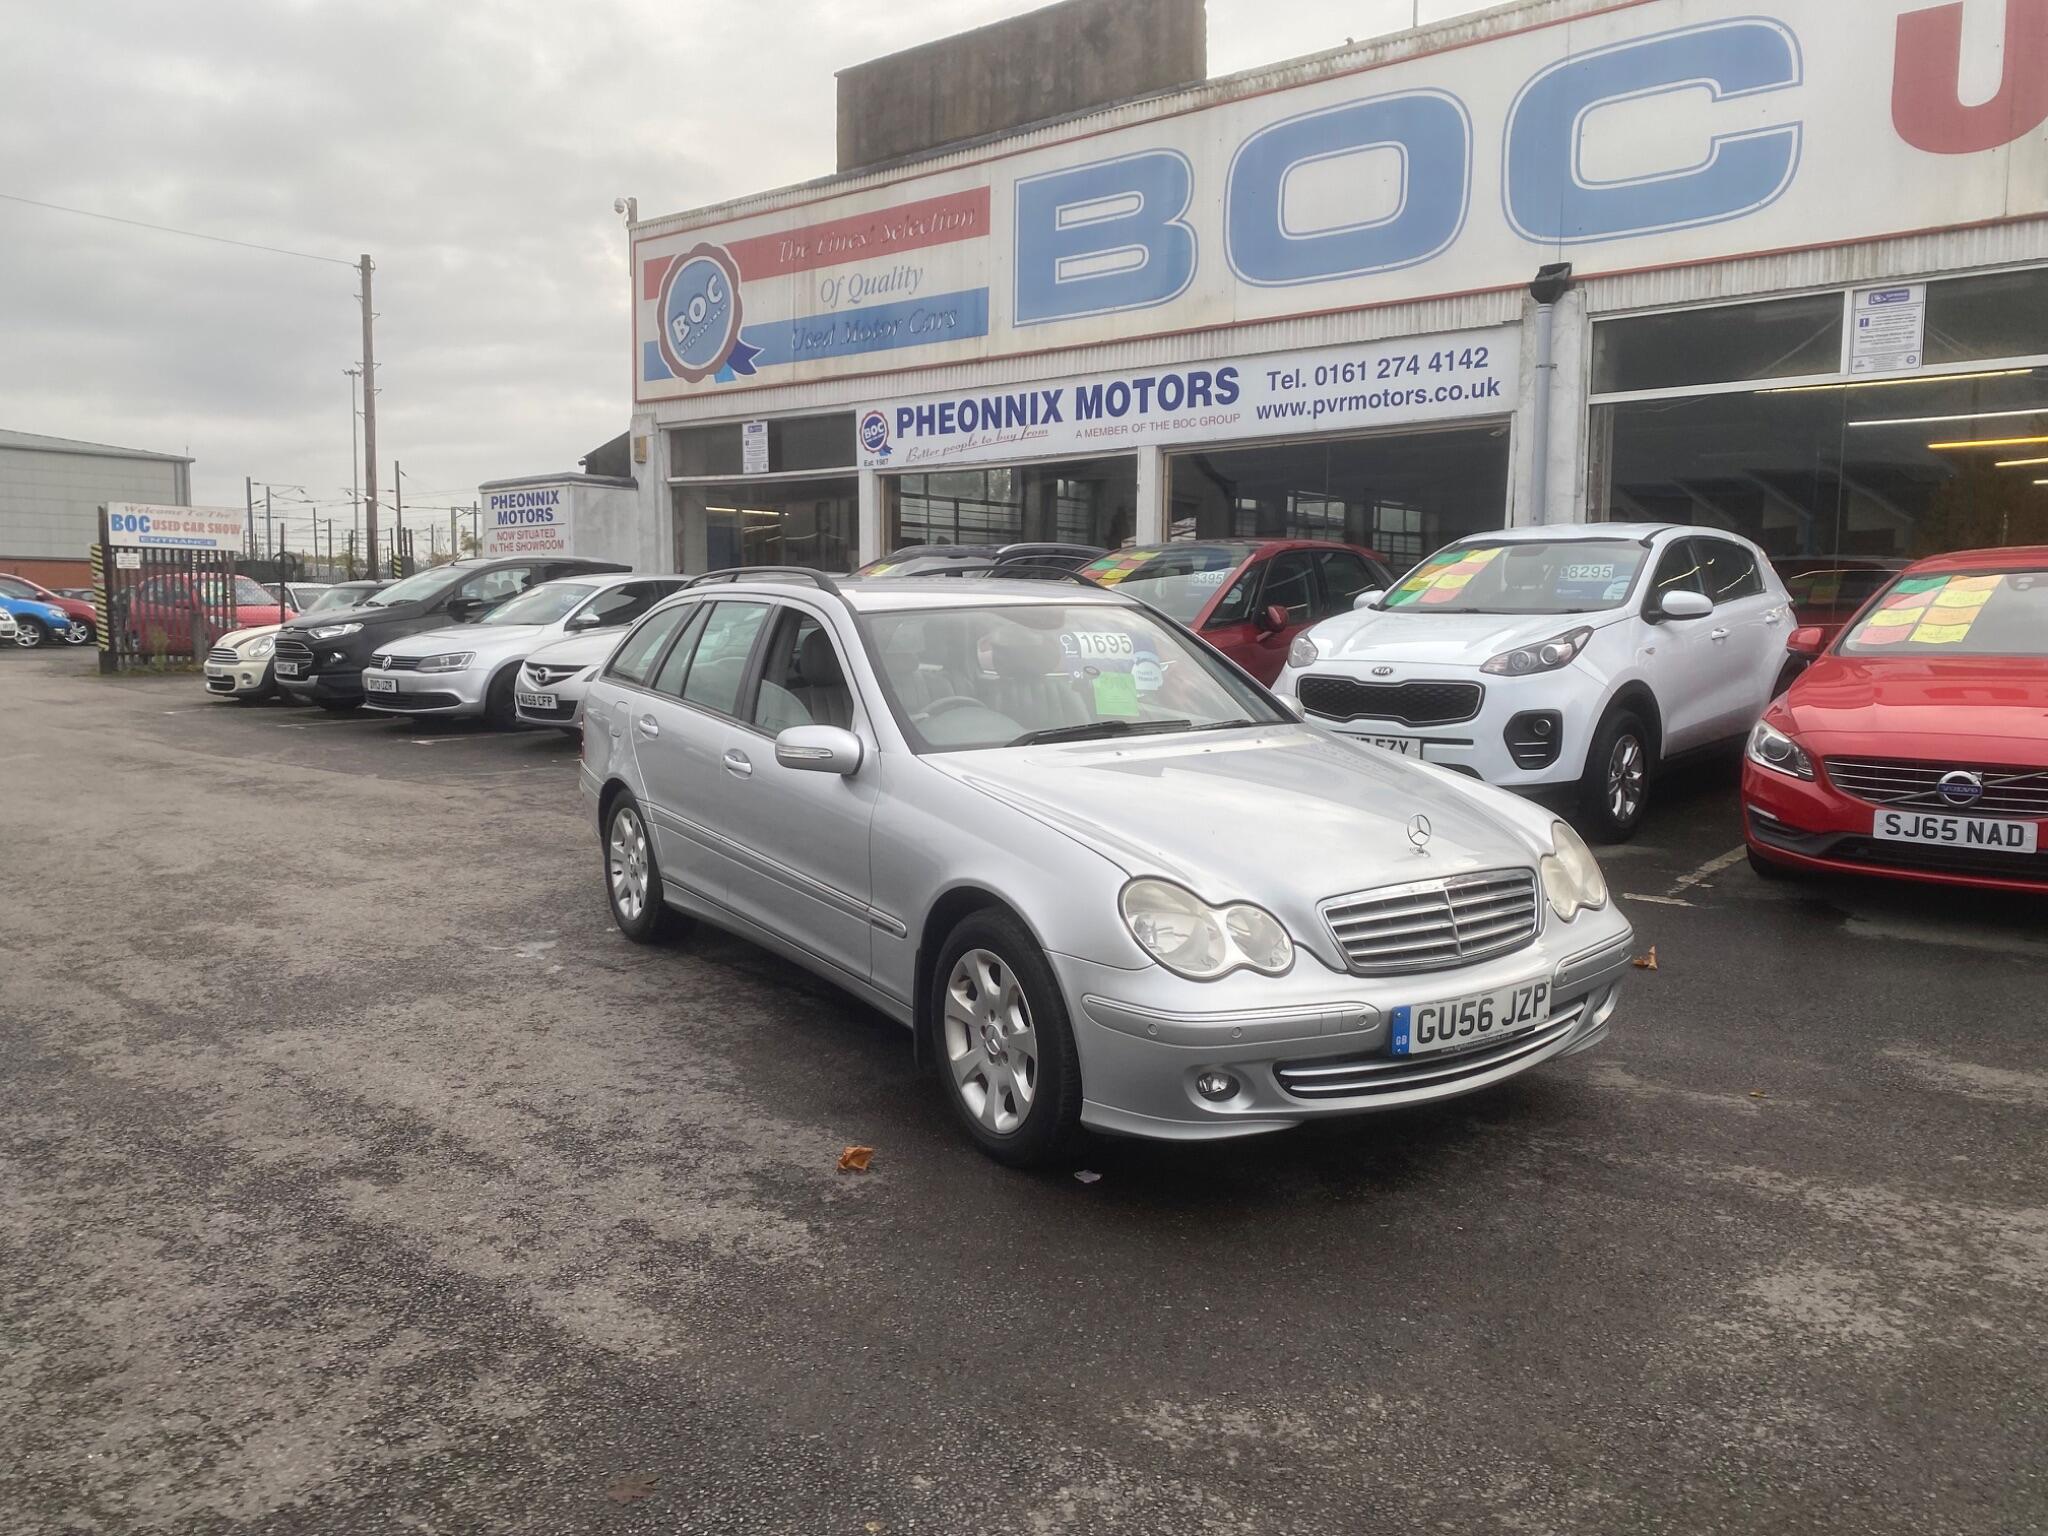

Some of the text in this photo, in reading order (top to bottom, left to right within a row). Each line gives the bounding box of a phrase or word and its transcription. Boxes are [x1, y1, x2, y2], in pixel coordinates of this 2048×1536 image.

[1013, 15, 1803, 328] BOC
[880, 207, 977, 245] Selection
[820, 264, 924, 309] Of Quality
[672, 273, 723, 343] BOC
[790, 308, 958, 352] Used Motor Cars
[1266, 346, 1490, 391] Tel. 0161 274 4142
[896, 366, 1240, 439] PHEONNIX MOTORS
[1256, 376, 1501, 420] www.pvrmotors.co.uk
[864, 421, 885, 439] BOC
[1076, 413, 1241, 439] A MEMBER OF THE BOC GROUP
[906, 424, 1049, 463] Better people to buy from
[124, 505, 181, 517] Welcome
[491, 490, 560, 509] PHEONNIX
[111, 513, 242, 535] BOC USED CAR SHOW
[497, 507, 554, 526] MOTORS
[140, 536, 214, 546] ENTRANCE
[489, 539, 565, 553] IN THE SHOWROOM
[496, 529, 555, 541] NOW SITUATED
[1373, 666, 1392, 675] KIA
[1942, 785, 1979, 794] VOLVO
[1885, 813, 2025, 848] SJ65 NAD
[1395, 1034, 1408, 1046] GB
[1416, 997, 1494, 1045] GU56
[1501, 982, 1548, 1027] JZP
